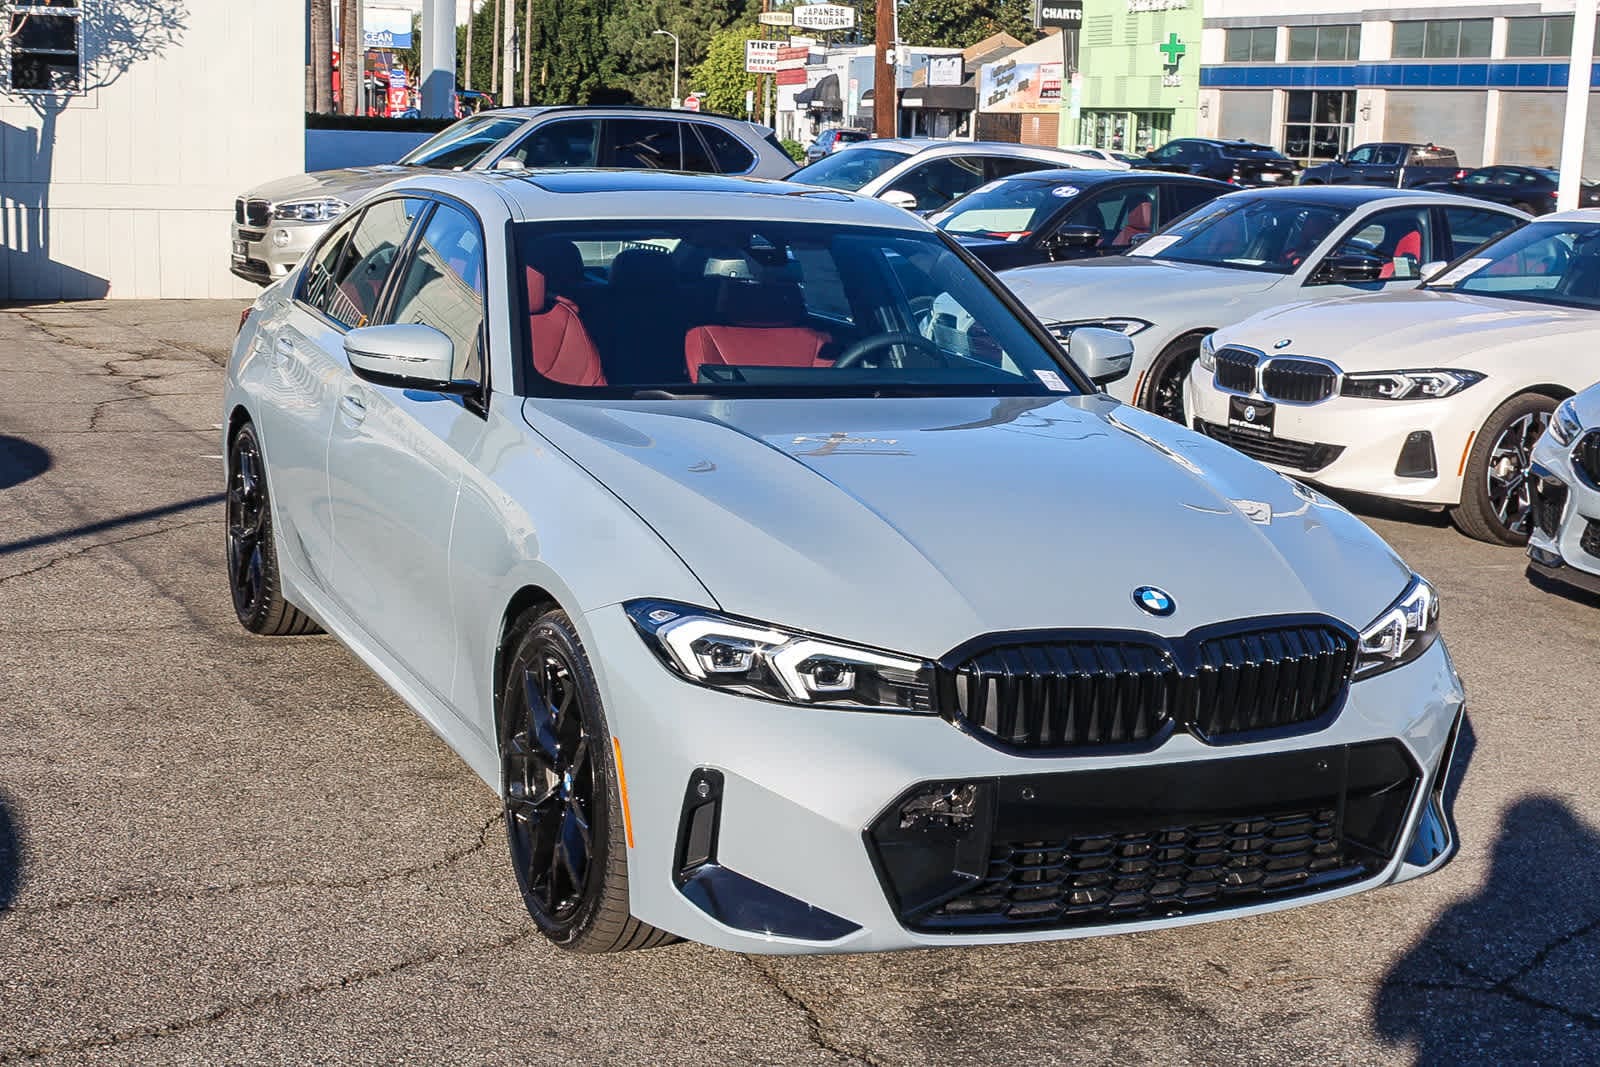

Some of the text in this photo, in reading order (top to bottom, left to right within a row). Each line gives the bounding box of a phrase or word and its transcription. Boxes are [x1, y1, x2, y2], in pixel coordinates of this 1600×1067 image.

[803, 7, 845, 17] JAPANESE
[1042, 8, 1082, 20] CHARTS
[798, 16, 850, 26] RESTAURANT
[364, 32, 393, 42] CEAN
[750, 42, 777, 50] TIRE
